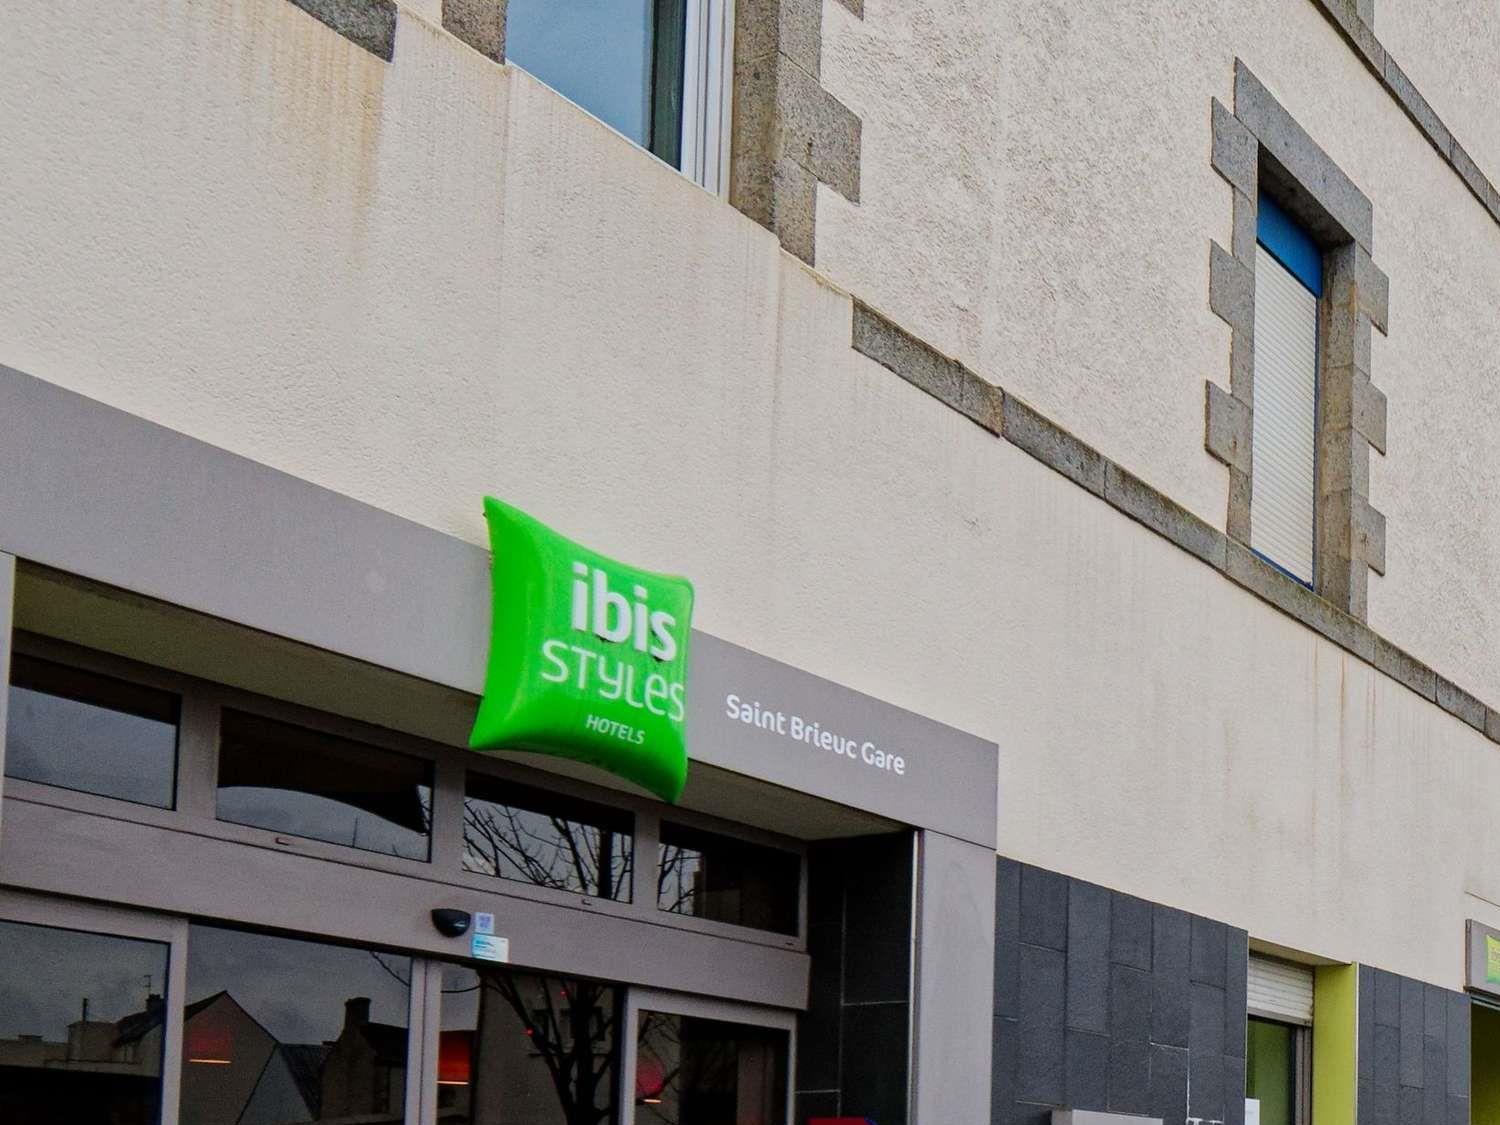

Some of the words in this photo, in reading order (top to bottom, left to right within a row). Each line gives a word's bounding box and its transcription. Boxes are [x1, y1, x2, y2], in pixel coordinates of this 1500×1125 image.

[572, 561, 677, 662] ibis
[586, 714, 646, 745] HOTELS
[726, 694, 786, 735] Saint
[790, 715, 857, 759] Brieuc
[861, 741, 905, 775] Gare
